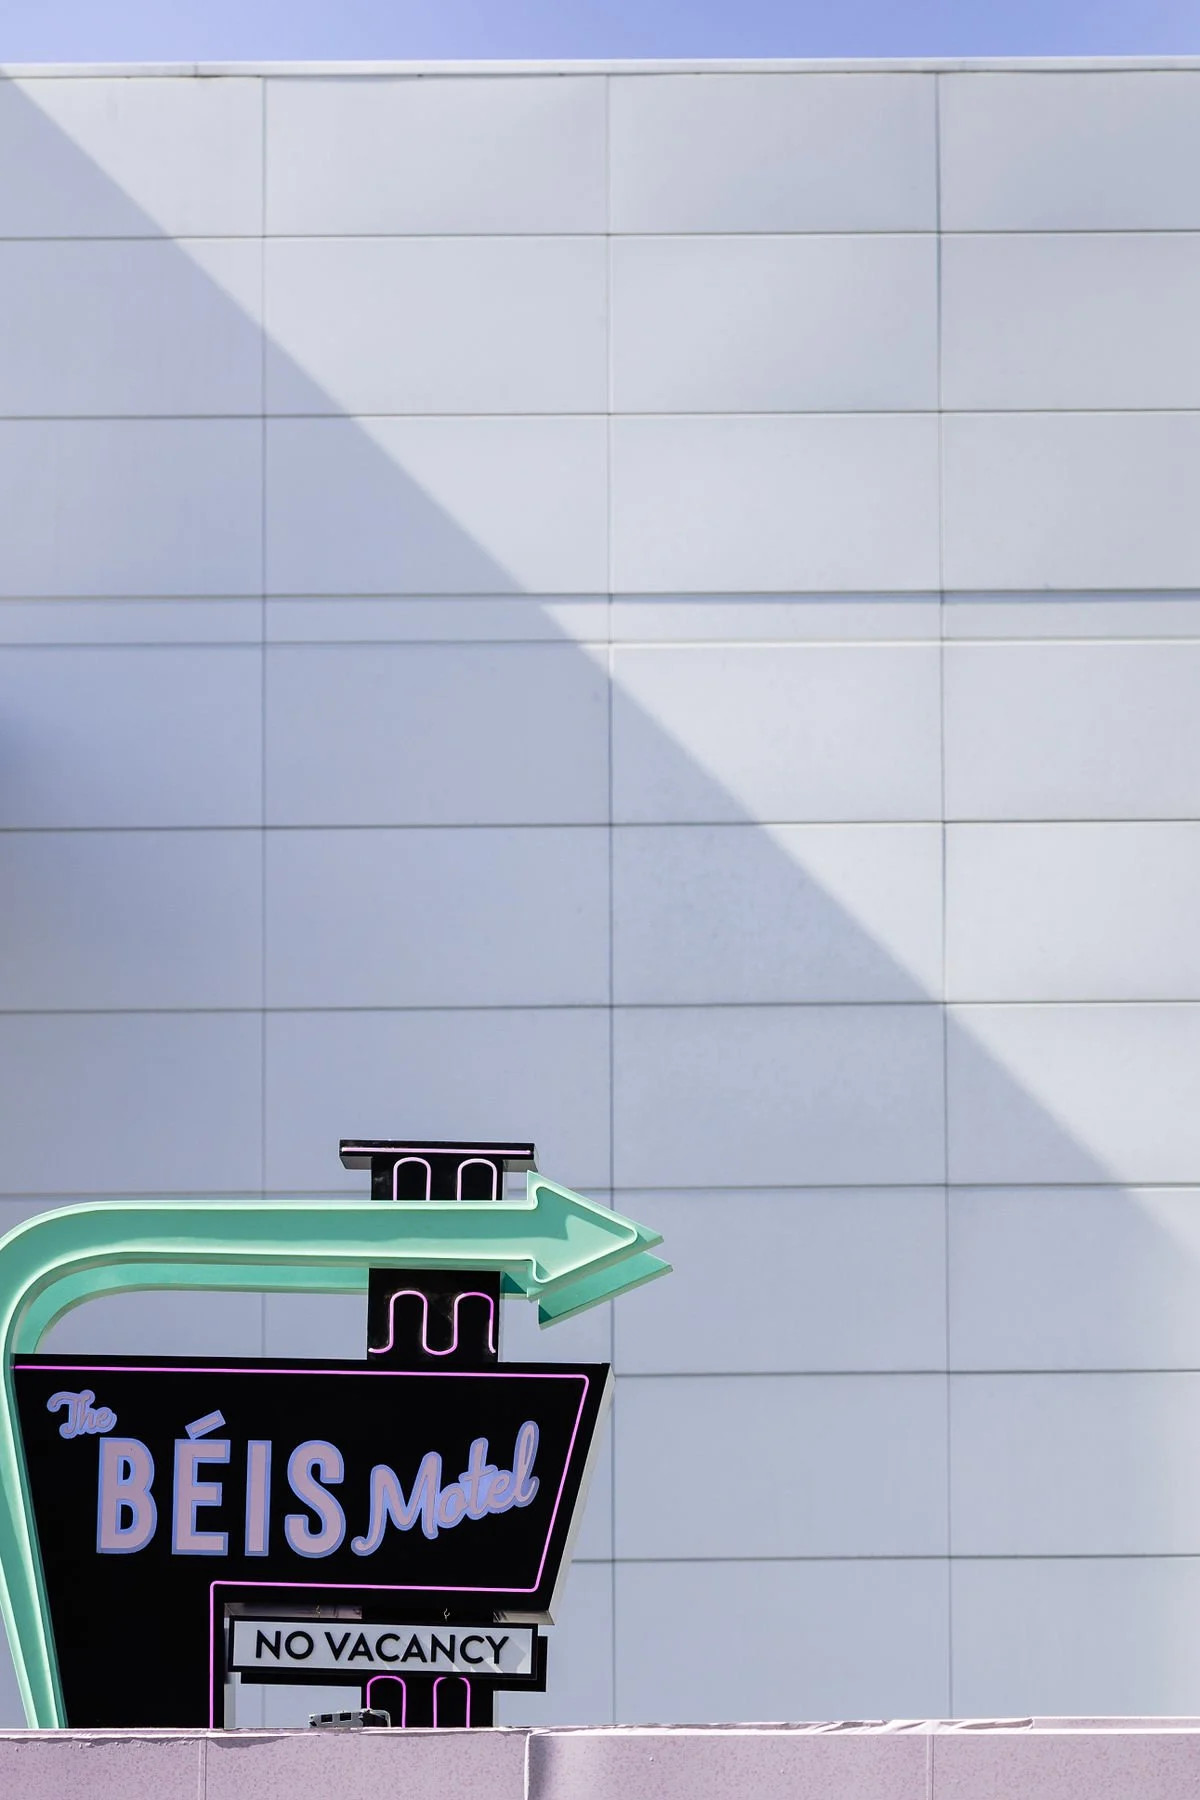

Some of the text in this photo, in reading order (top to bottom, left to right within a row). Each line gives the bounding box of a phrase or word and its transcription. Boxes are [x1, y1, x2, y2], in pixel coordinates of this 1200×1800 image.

[47, 1390, 539, 1558] The BÉIS Motel
[256, 1630, 510, 1665] NO VACANCY
